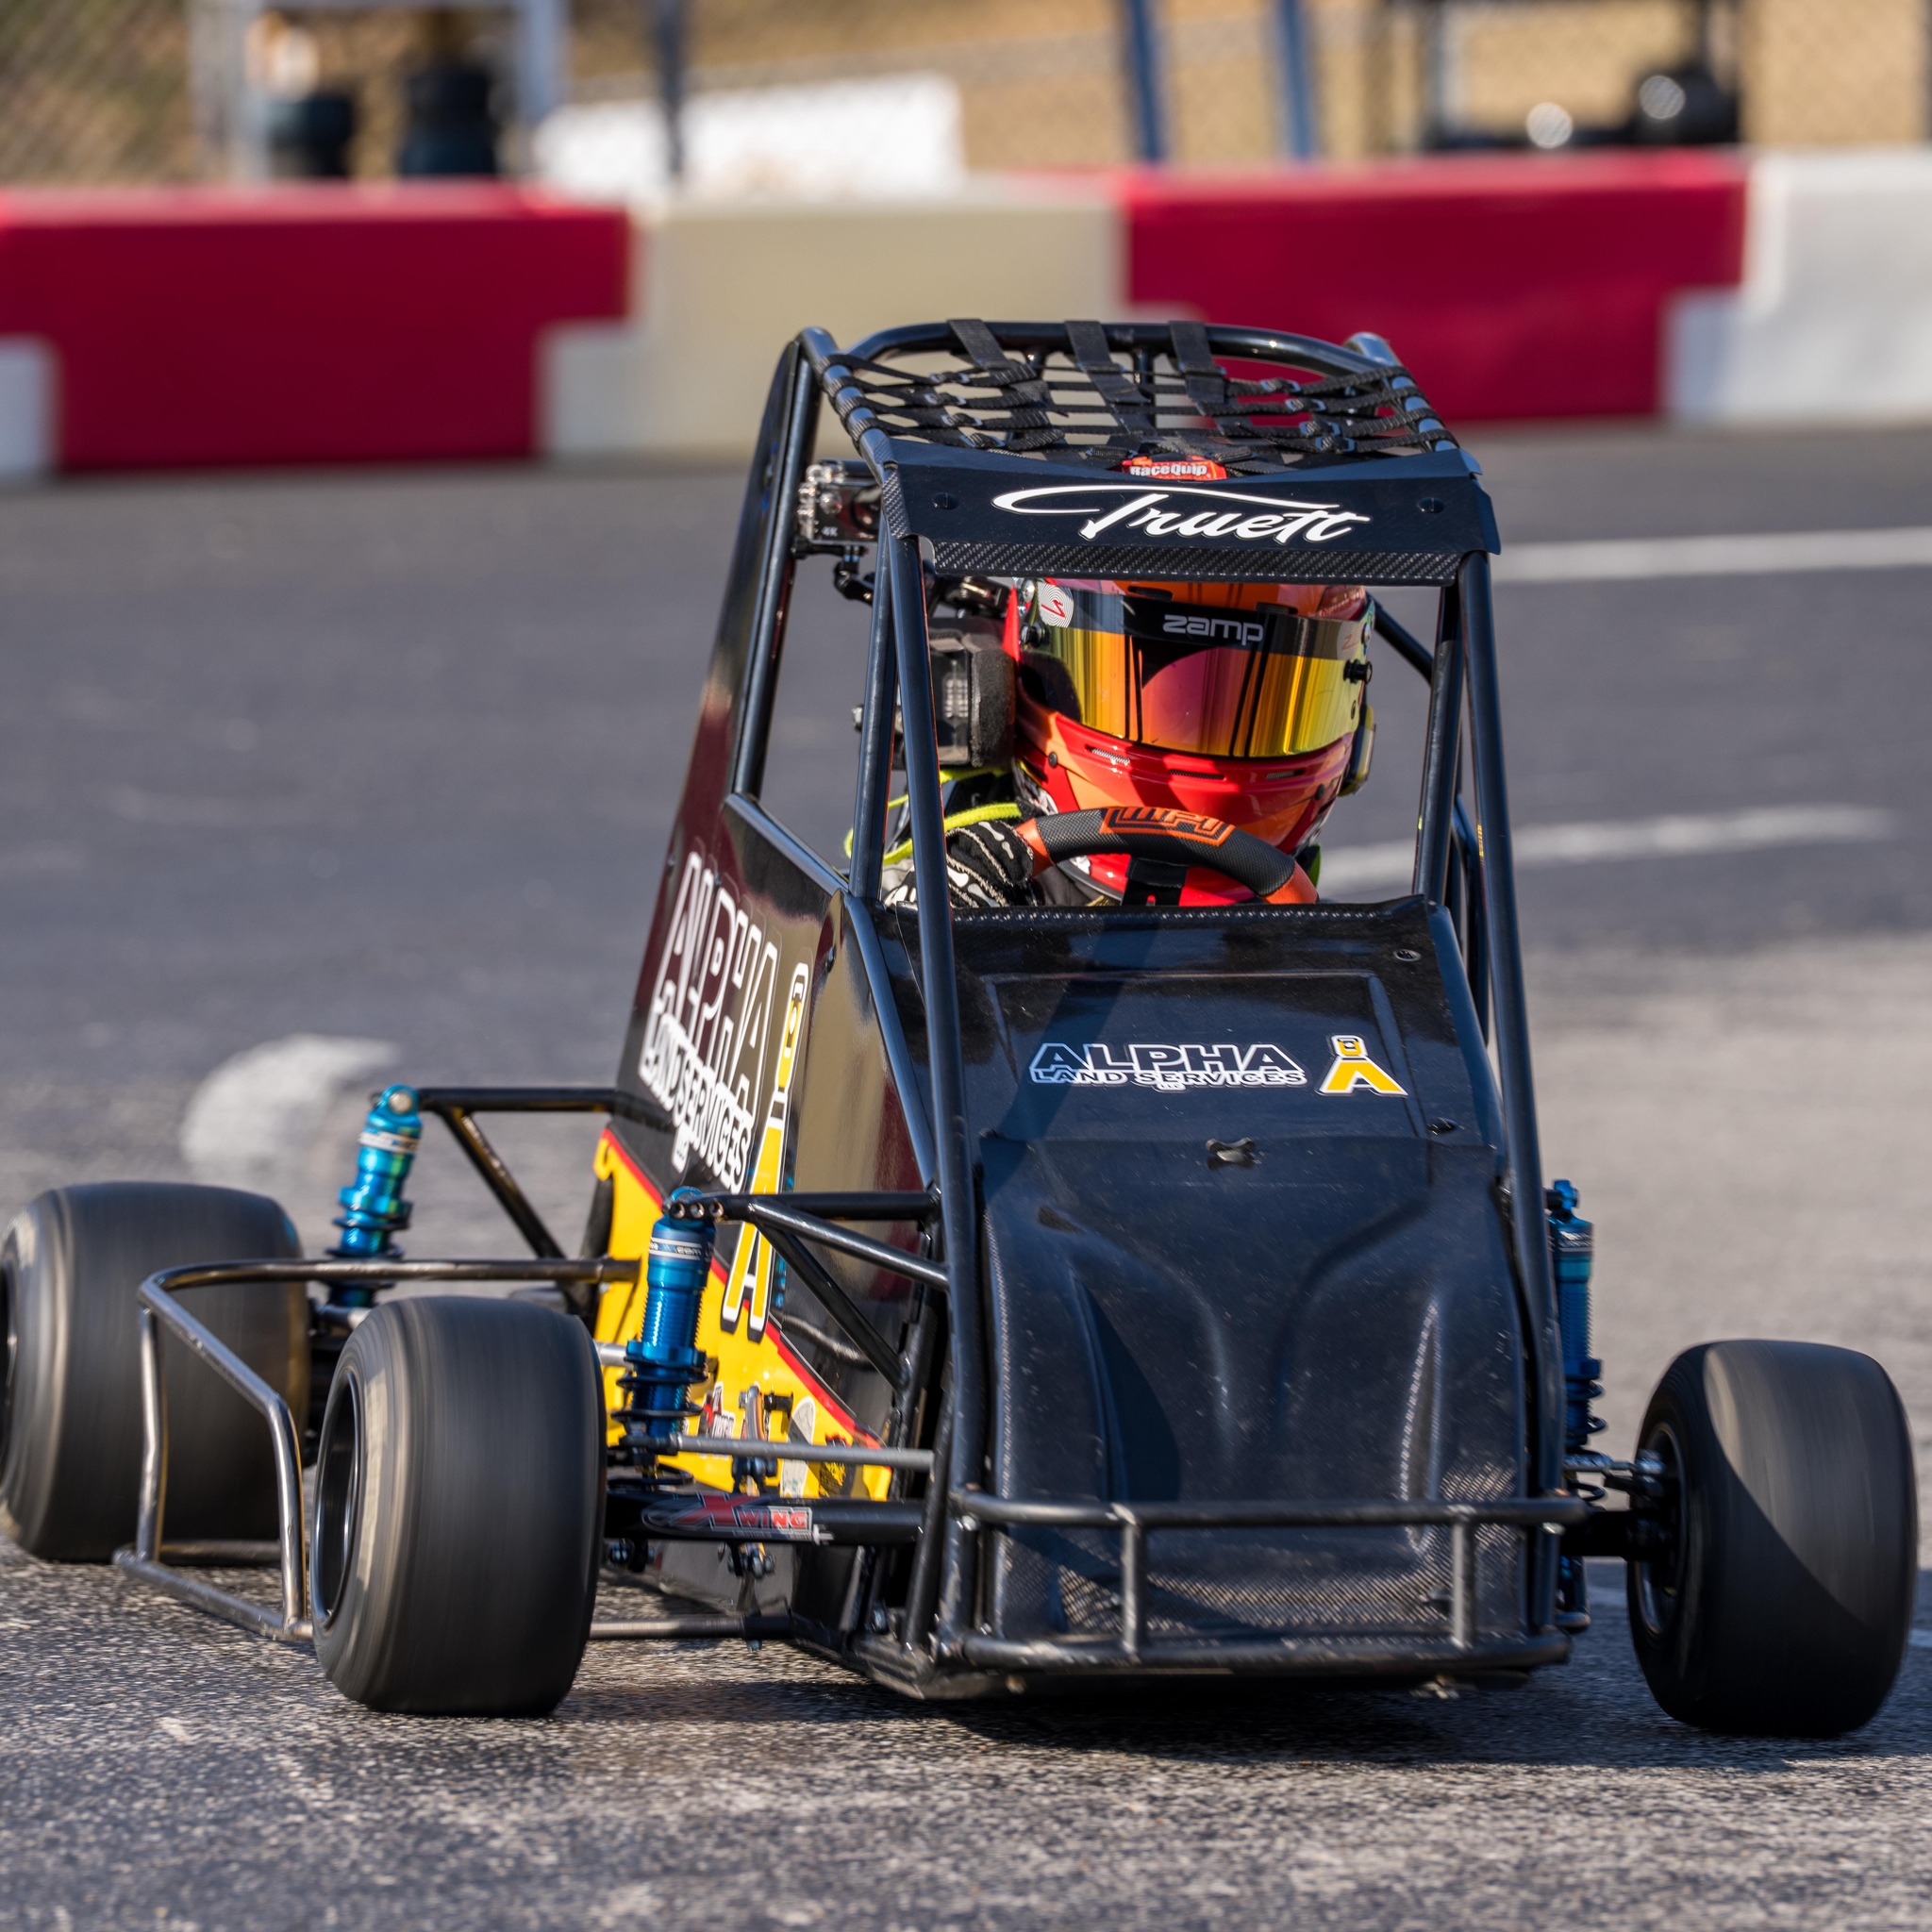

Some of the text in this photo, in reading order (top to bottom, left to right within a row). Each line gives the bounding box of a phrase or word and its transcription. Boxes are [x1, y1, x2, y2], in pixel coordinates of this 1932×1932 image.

[991, 484, 1371, 545] Truett
[1162, 614, 1264, 646] zamp
[1029, 1042, 1305, 1072] ALPHA
[1030, 1069, 1128, 1084] LAND
[1133, 1070, 1308, 1087] SERVICES
